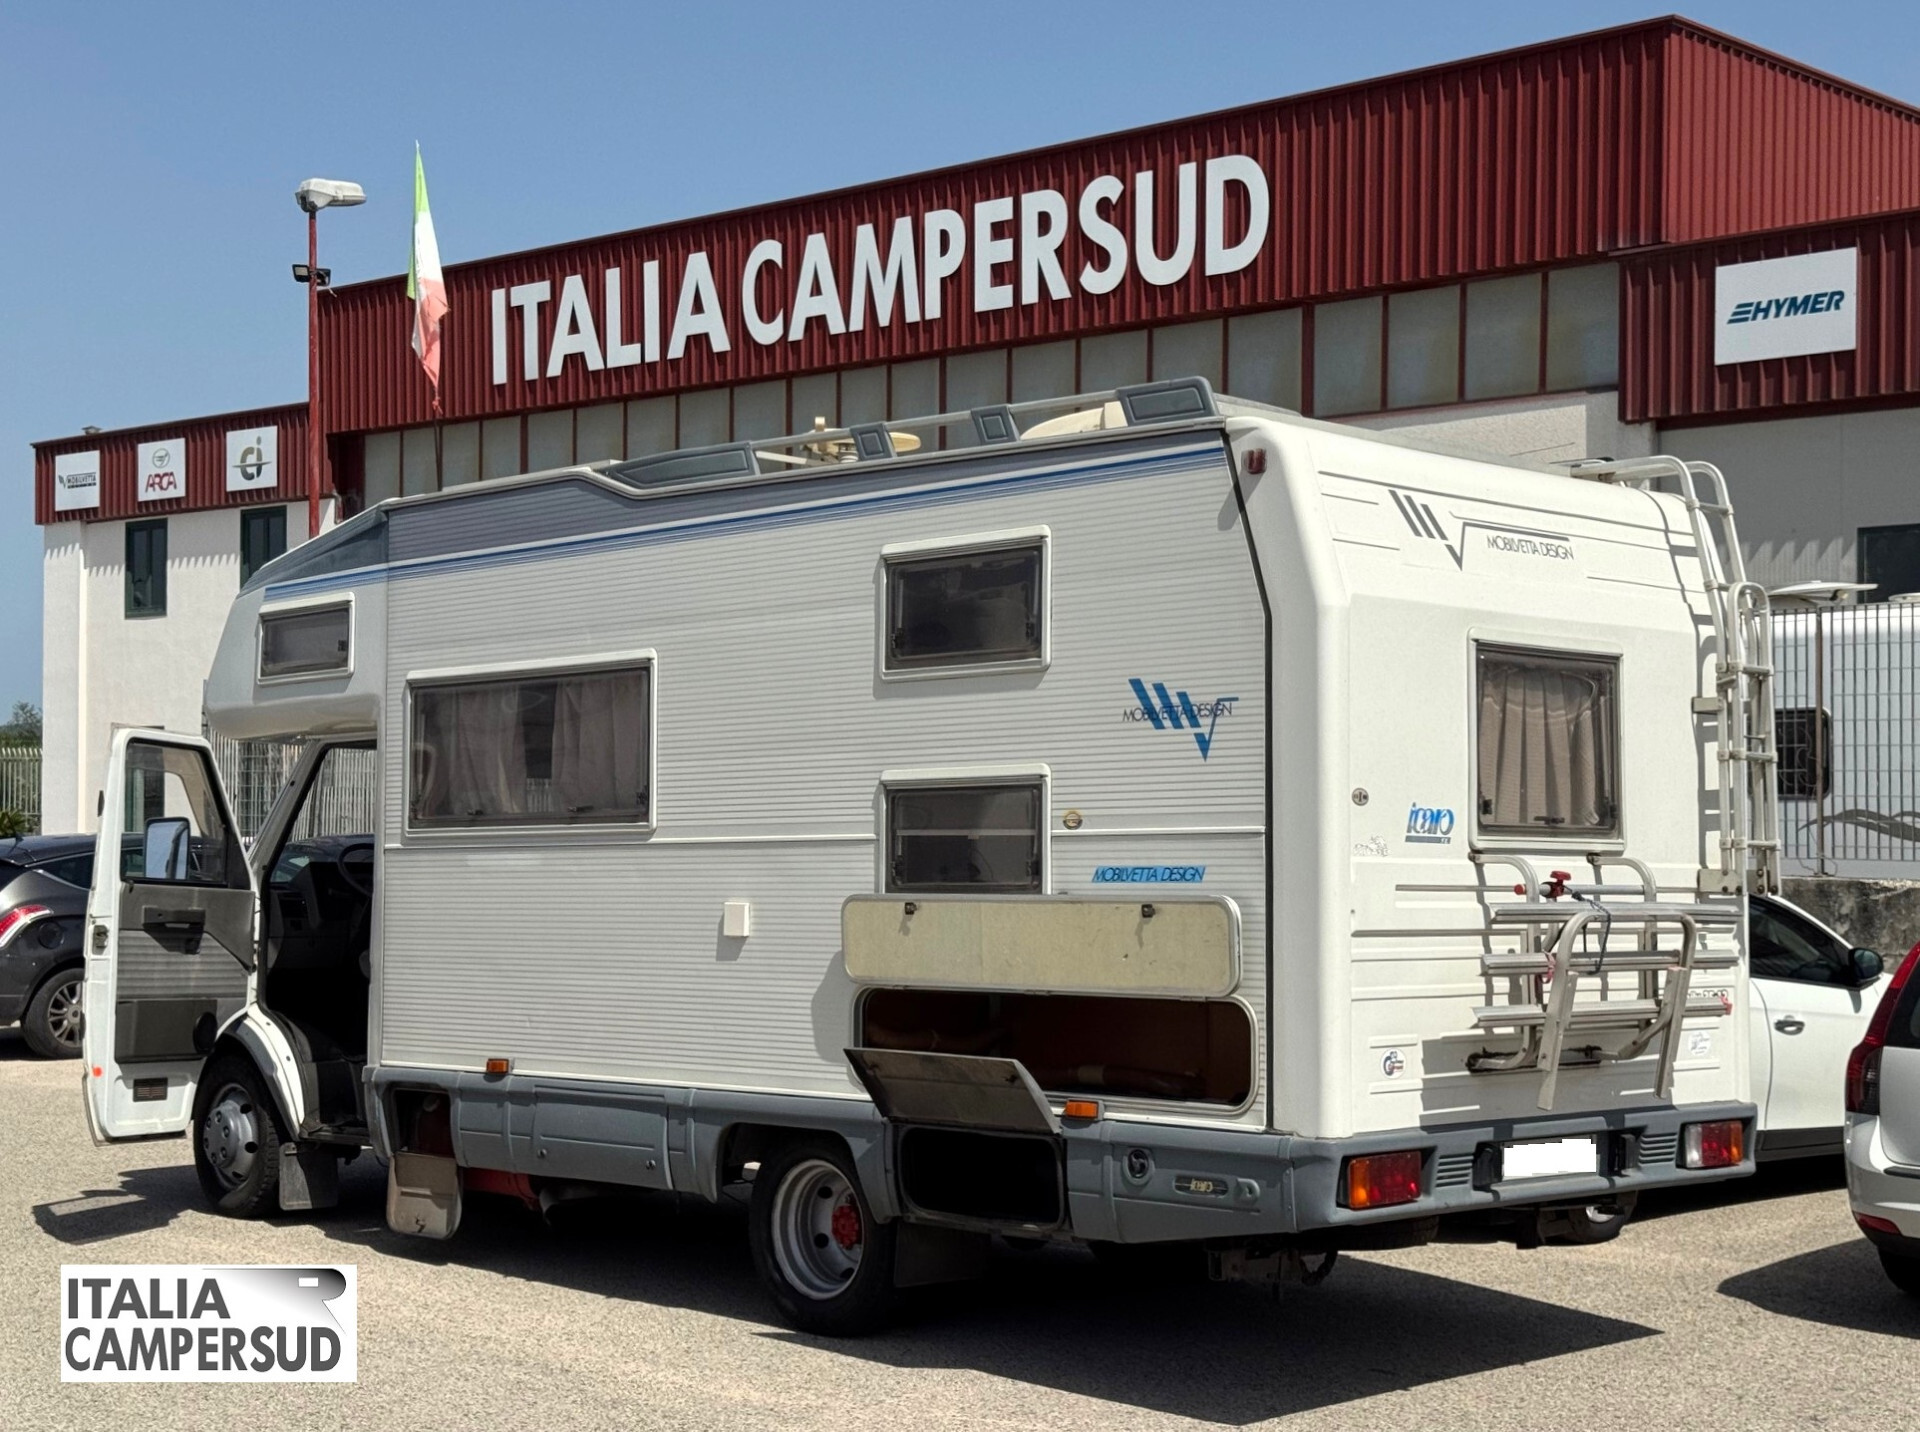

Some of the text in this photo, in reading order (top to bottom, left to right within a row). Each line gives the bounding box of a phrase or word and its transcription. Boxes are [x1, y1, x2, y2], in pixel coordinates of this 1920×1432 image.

[492, 154, 1270, 385] ITALIA CAMPERSUD
[1750, 290, 1845, 321] HYMER
[145, 471, 177, 492] ARCA
[1487, 534, 1575, 560] MOBILVETTA DESIGN
[1122, 702, 1233, 722] MOBILVETTA DESIGN
[1093, 867, 1205, 882] MOBILVETTA DESIGN
